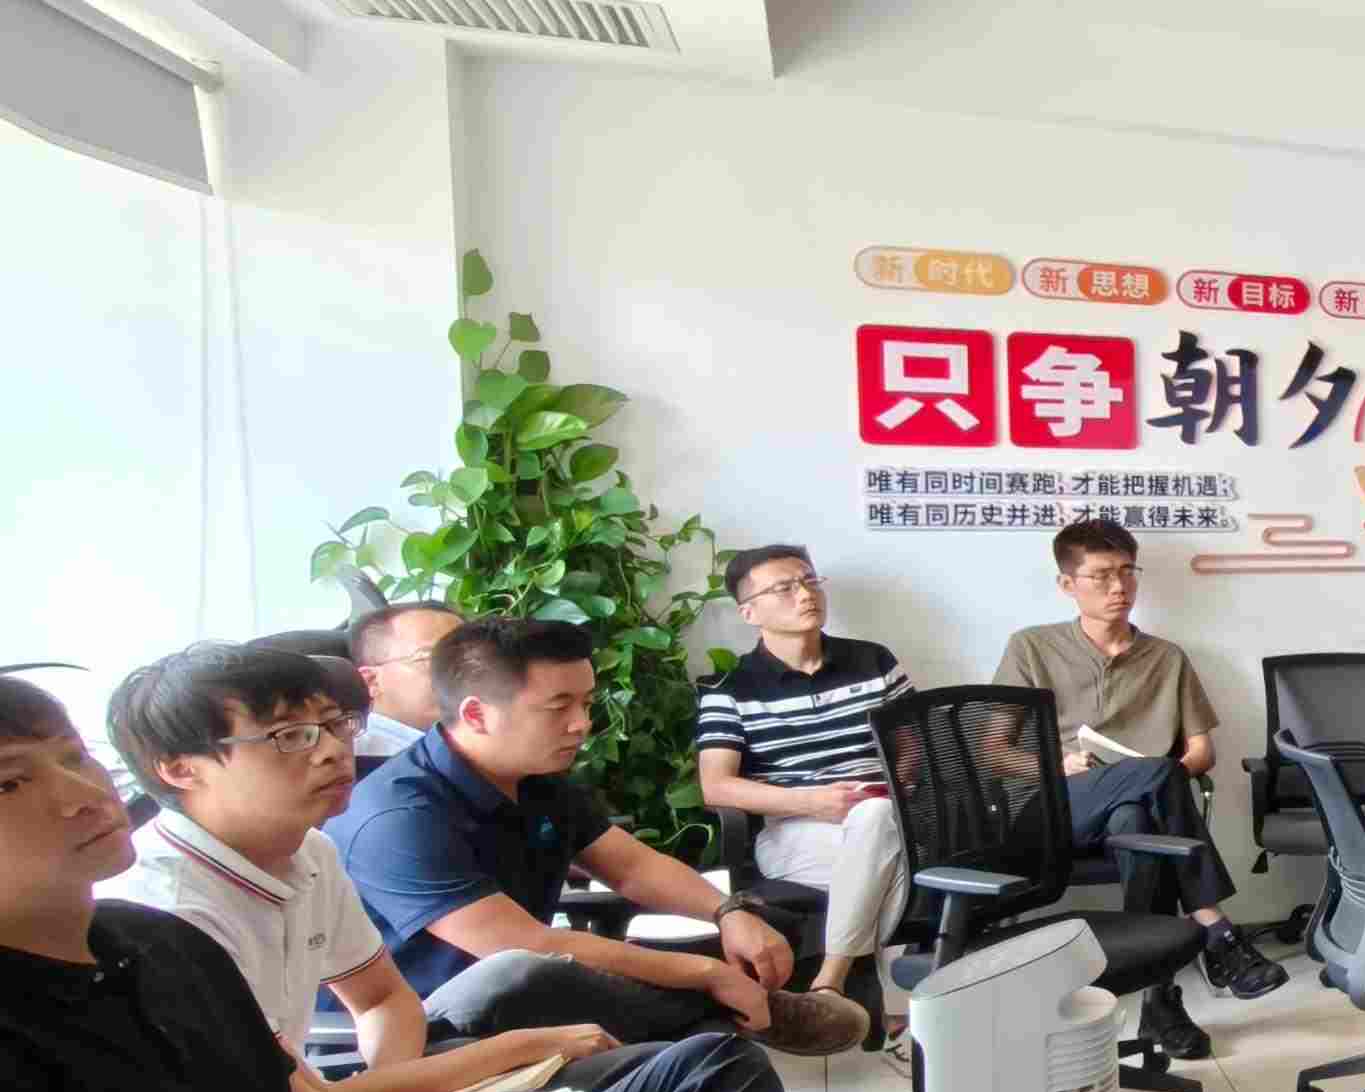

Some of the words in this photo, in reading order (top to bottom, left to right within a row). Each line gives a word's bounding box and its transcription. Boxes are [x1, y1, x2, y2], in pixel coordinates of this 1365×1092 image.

[873, 255, 994, 289] 新时代
[1038, 267, 1151, 298] 新思想
[1193, 278, 1296, 309] 新目标
[873, 329, 1358, 450] 只争朝夕
